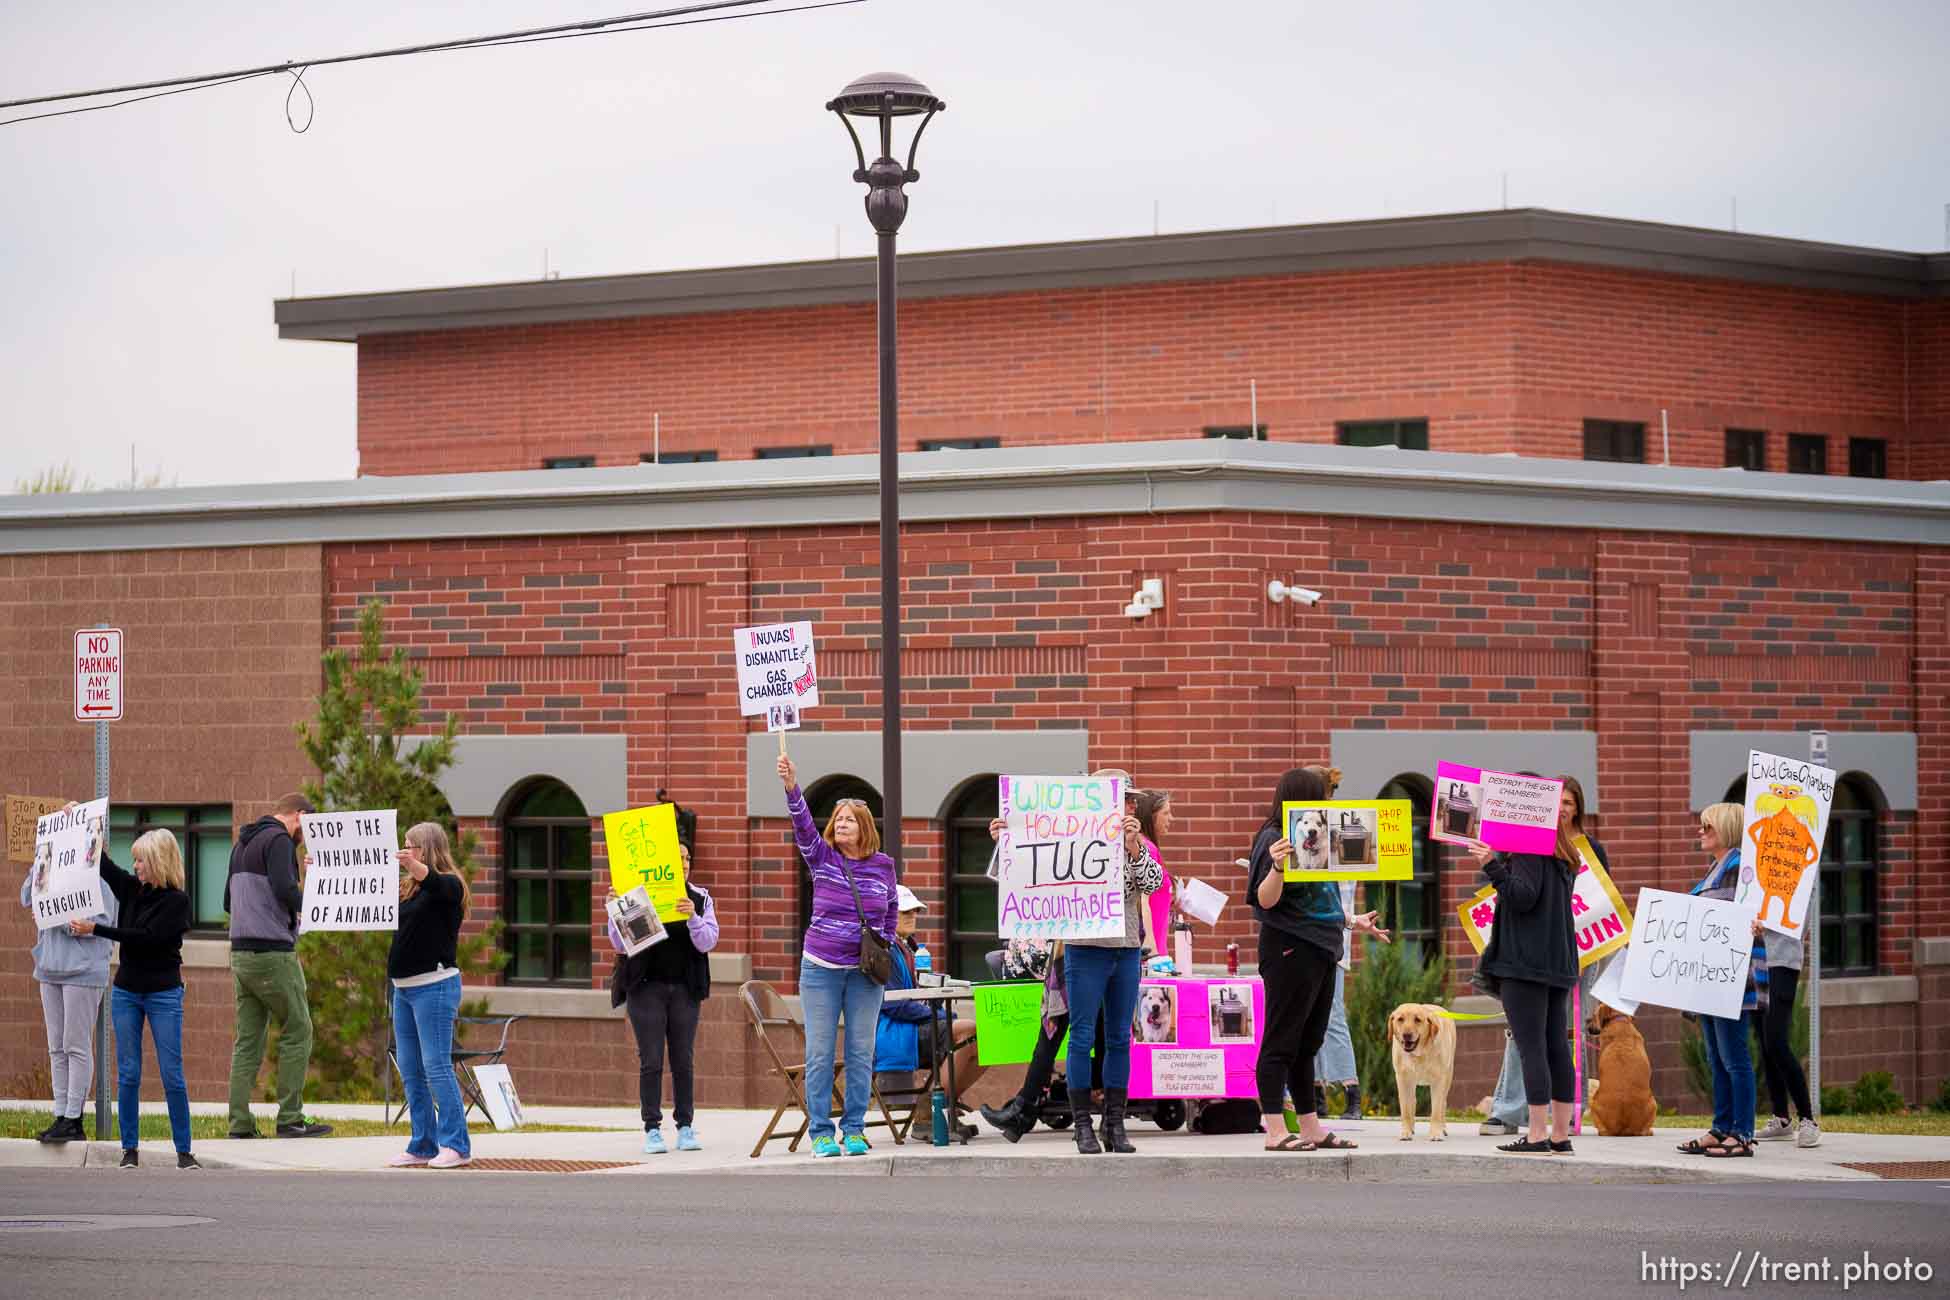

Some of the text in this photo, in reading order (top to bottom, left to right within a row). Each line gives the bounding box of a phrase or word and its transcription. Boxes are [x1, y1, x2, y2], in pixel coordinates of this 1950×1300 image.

[88, 637, 109, 654] NO
[79, 656, 118, 674] PARKING
[745, 648, 799, 667] DISMANTLE
[88, 675, 110, 687] ANY
[766, 669, 787, 684] GAS
[86, 689, 111, 701] TIME
[746, 681, 794, 700] CHAMBER
[1778, 761, 1799, 782] Gas
[1488, 776, 1556, 792] DESTROY THE GAS
[1487, 799, 1504, 807] FIRE
[1505, 801, 1517, 809] THE
[38, 808, 87, 836] #JUSTICE
[1490, 809, 1546, 823] TUG GETTLING
[309, 818, 382, 839] STOP THE
[1025, 812, 1121, 842] HOLDING
[58, 848, 76, 869] FOR
[317, 848, 389, 868] INHUMANE
[1016, 840, 1109, 885] TUG
[639, 864, 675, 882] TUG
[317, 876, 384, 895] KILLING!
[39, 889, 92, 918] PENGUIN!
[311, 905, 394, 923] OF ANIMALS
[1699, 909, 1730, 944] Gas
[1650, 948, 1746, 984] Chambers!
